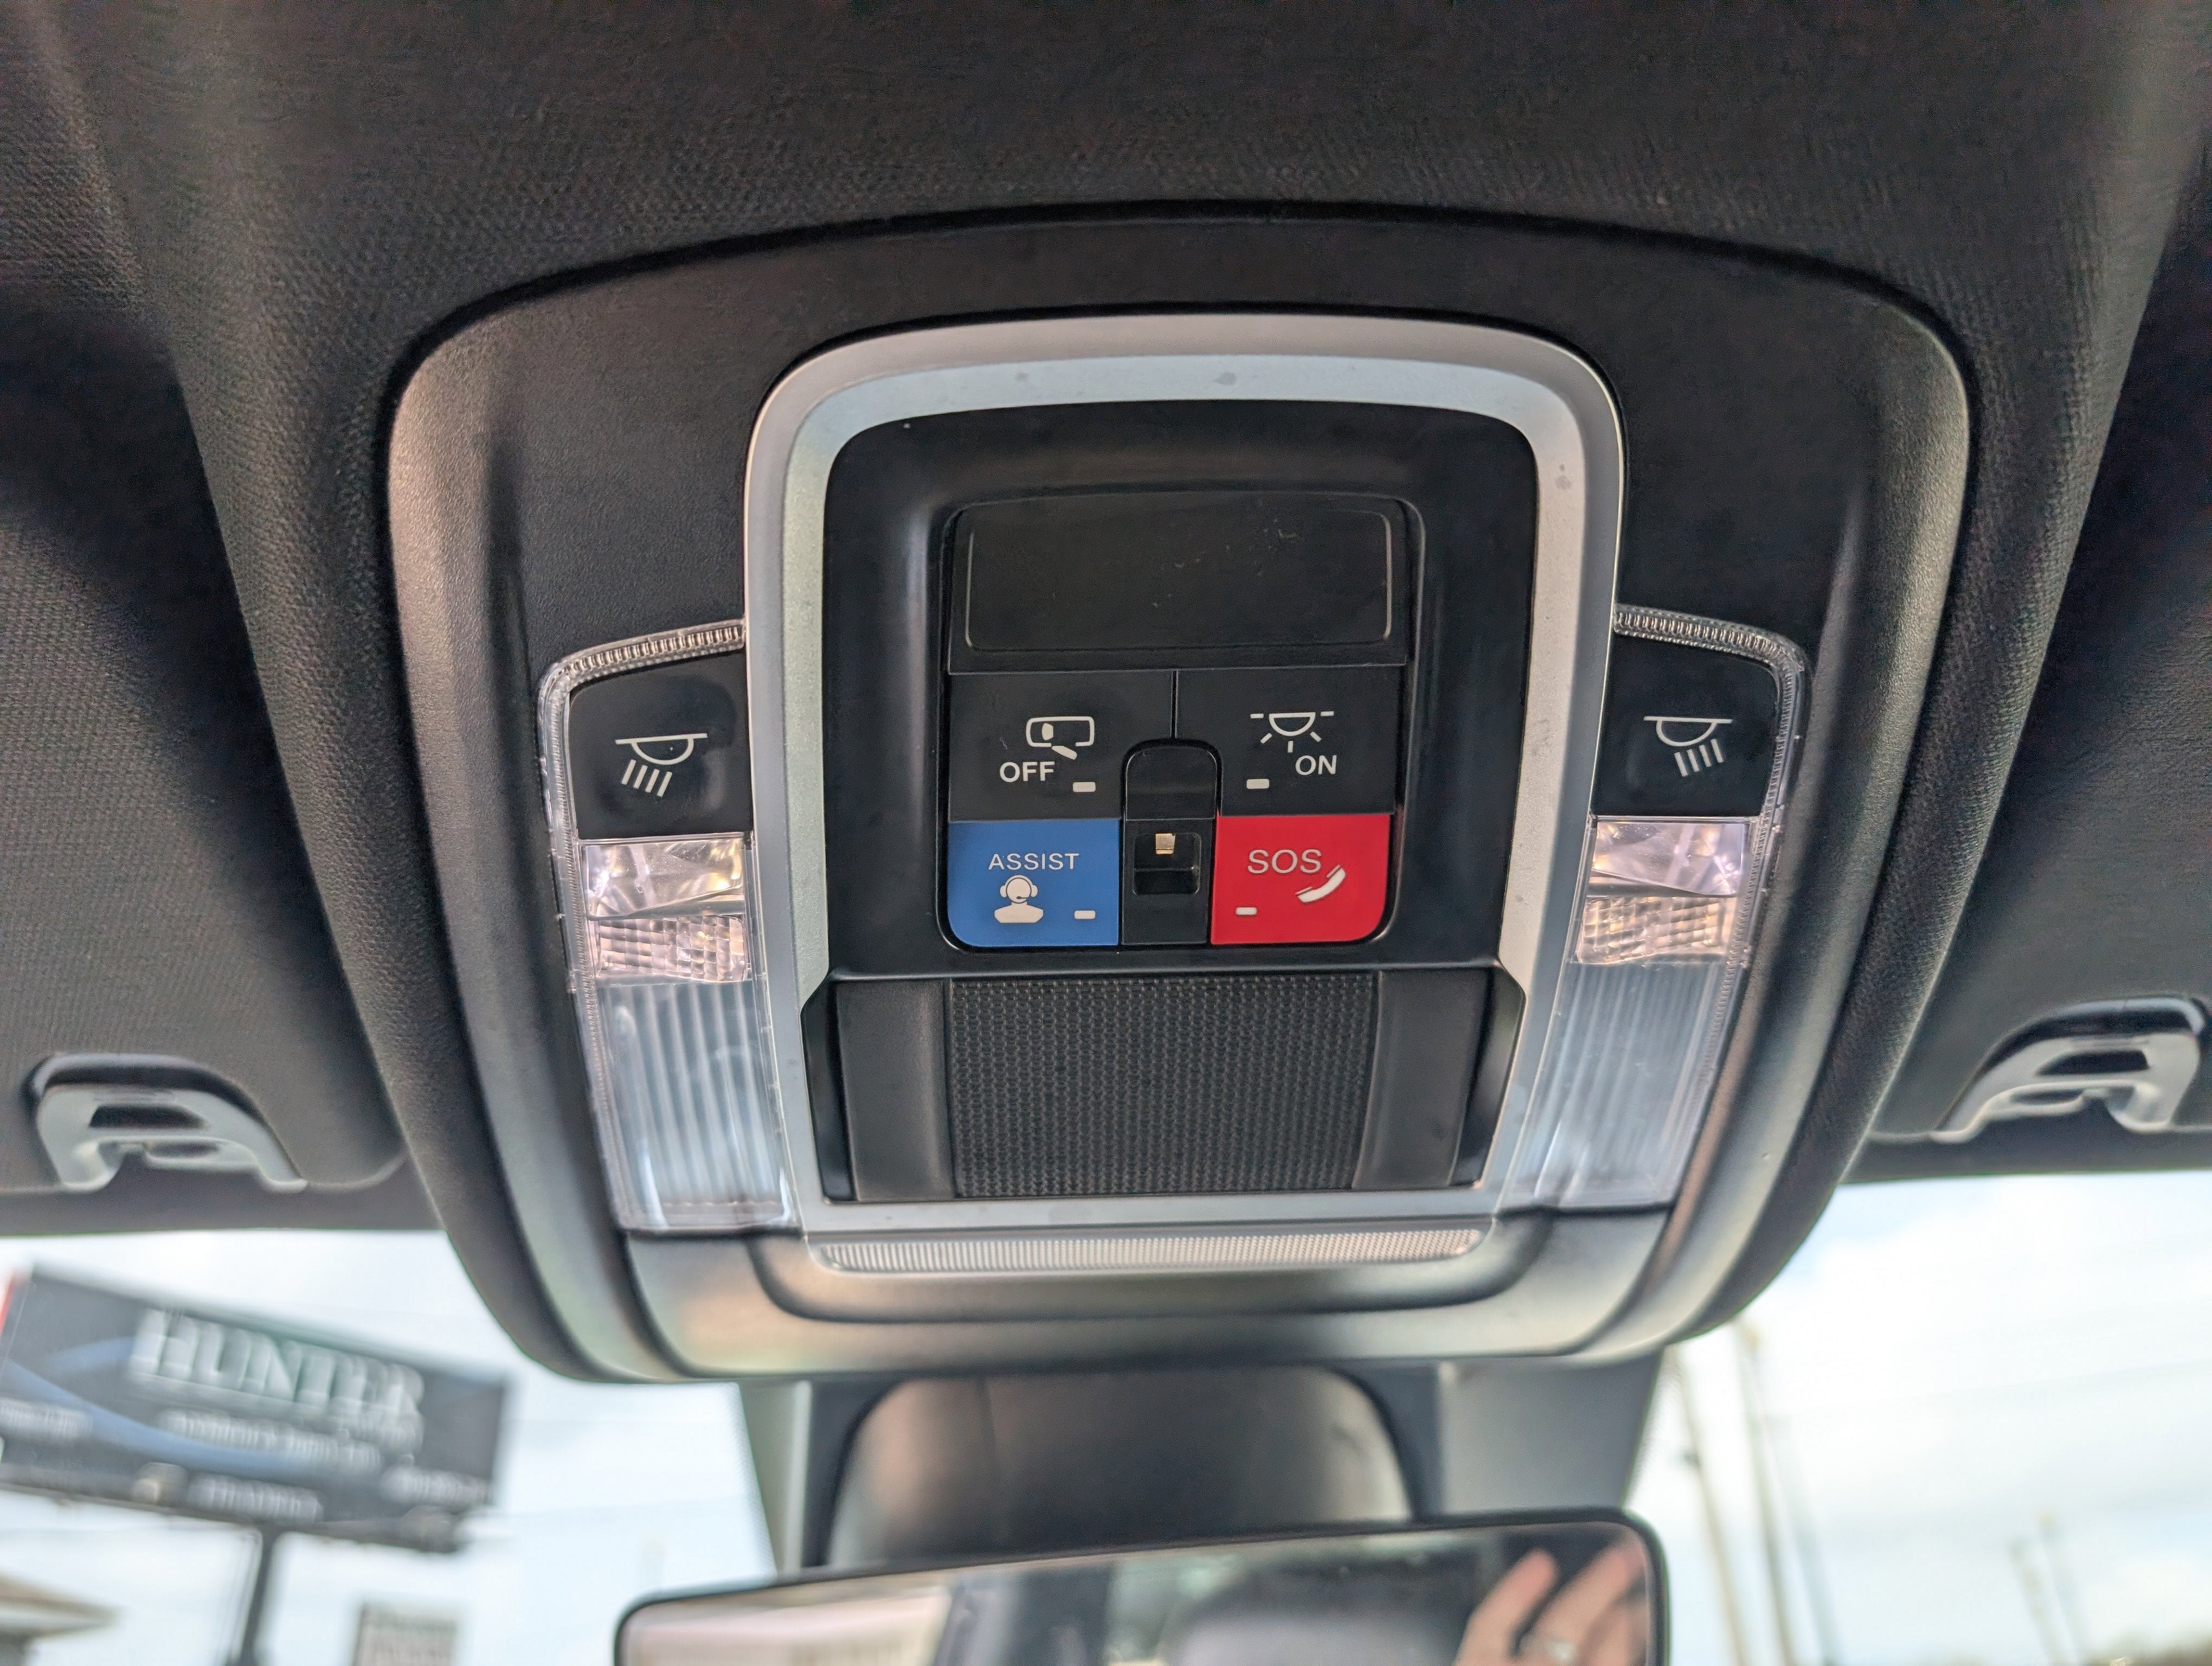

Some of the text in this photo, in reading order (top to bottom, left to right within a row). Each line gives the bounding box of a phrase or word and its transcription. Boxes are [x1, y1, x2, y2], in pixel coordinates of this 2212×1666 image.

[1000, 761, 1055, 783] OFF
[1295, 755, 1338, 776] ON
[988, 853, 1080, 871] ASSIST
[1248, 849, 1322, 874] SOS
